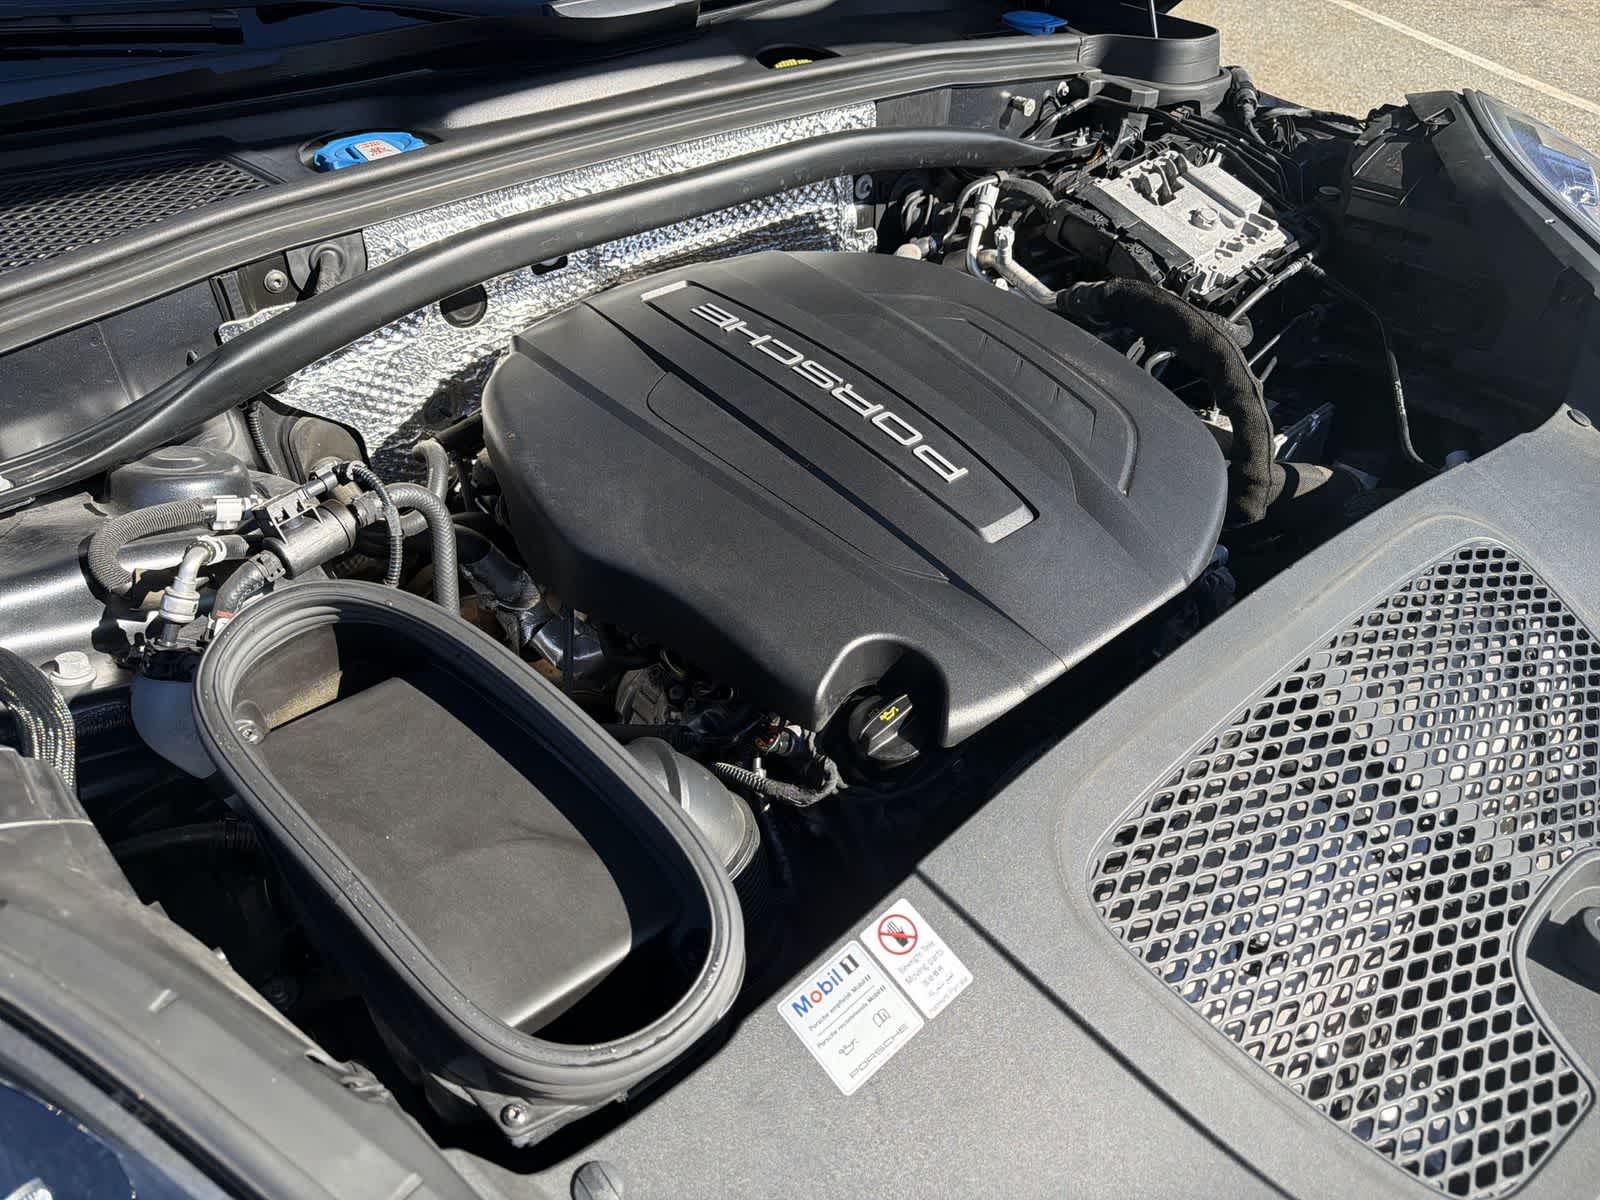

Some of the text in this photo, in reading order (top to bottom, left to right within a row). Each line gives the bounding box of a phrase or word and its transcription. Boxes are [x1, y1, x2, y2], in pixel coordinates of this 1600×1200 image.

[689, 303, 968, 484] PORSCHE
[792, 968, 844, 1018] Mobil
[808, 1011, 830, 1032] Porsche
[817, 1029, 838, 1049] Porsche
[850, 1023, 909, 1079] PORSCHE
